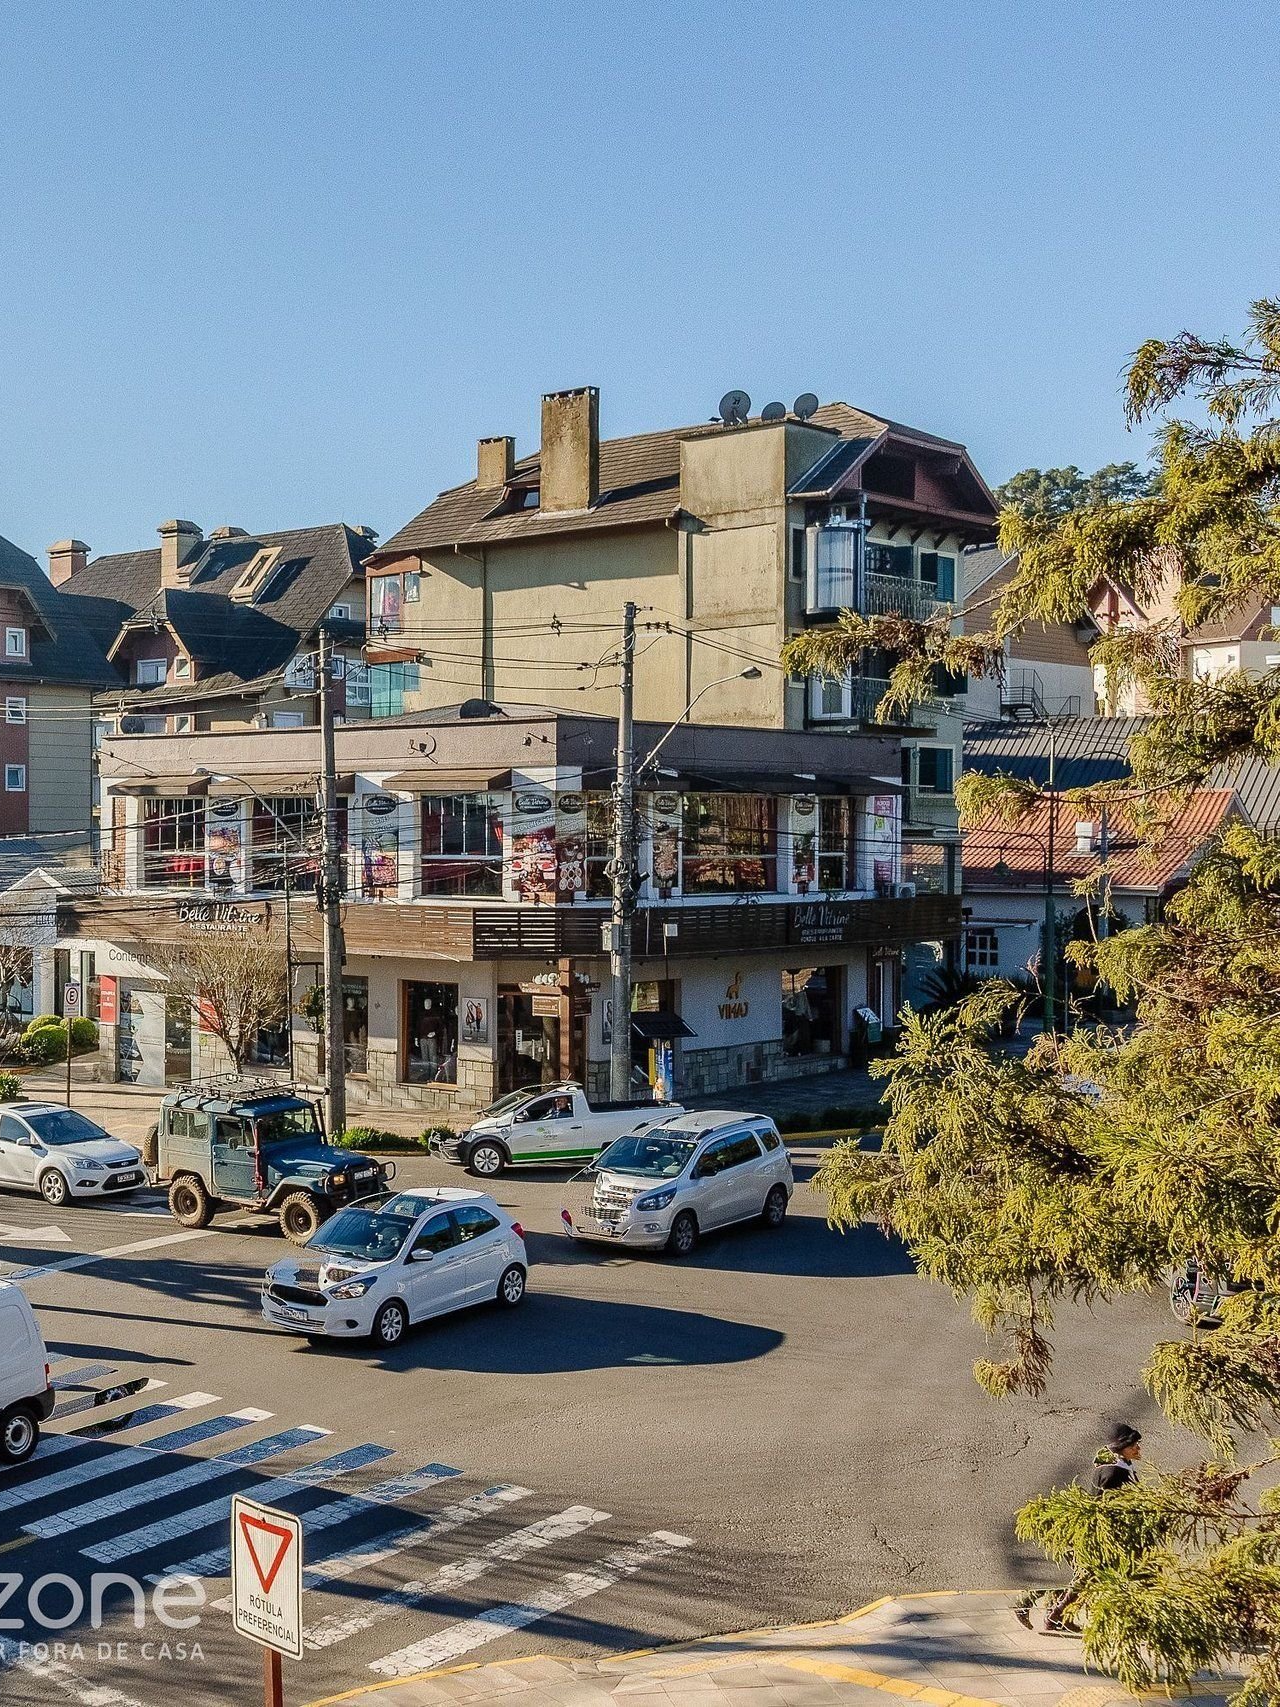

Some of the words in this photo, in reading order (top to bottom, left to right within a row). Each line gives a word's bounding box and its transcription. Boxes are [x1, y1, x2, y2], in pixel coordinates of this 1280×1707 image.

[794, 905, 817, 928] Belle
[819, 905, 850, 926] Vitrine
[70, 991, 75, 1001] E
[249, 1594, 283, 1619] RÓTULA
[238, 1608, 297, 1645] PREFERENCIAL
